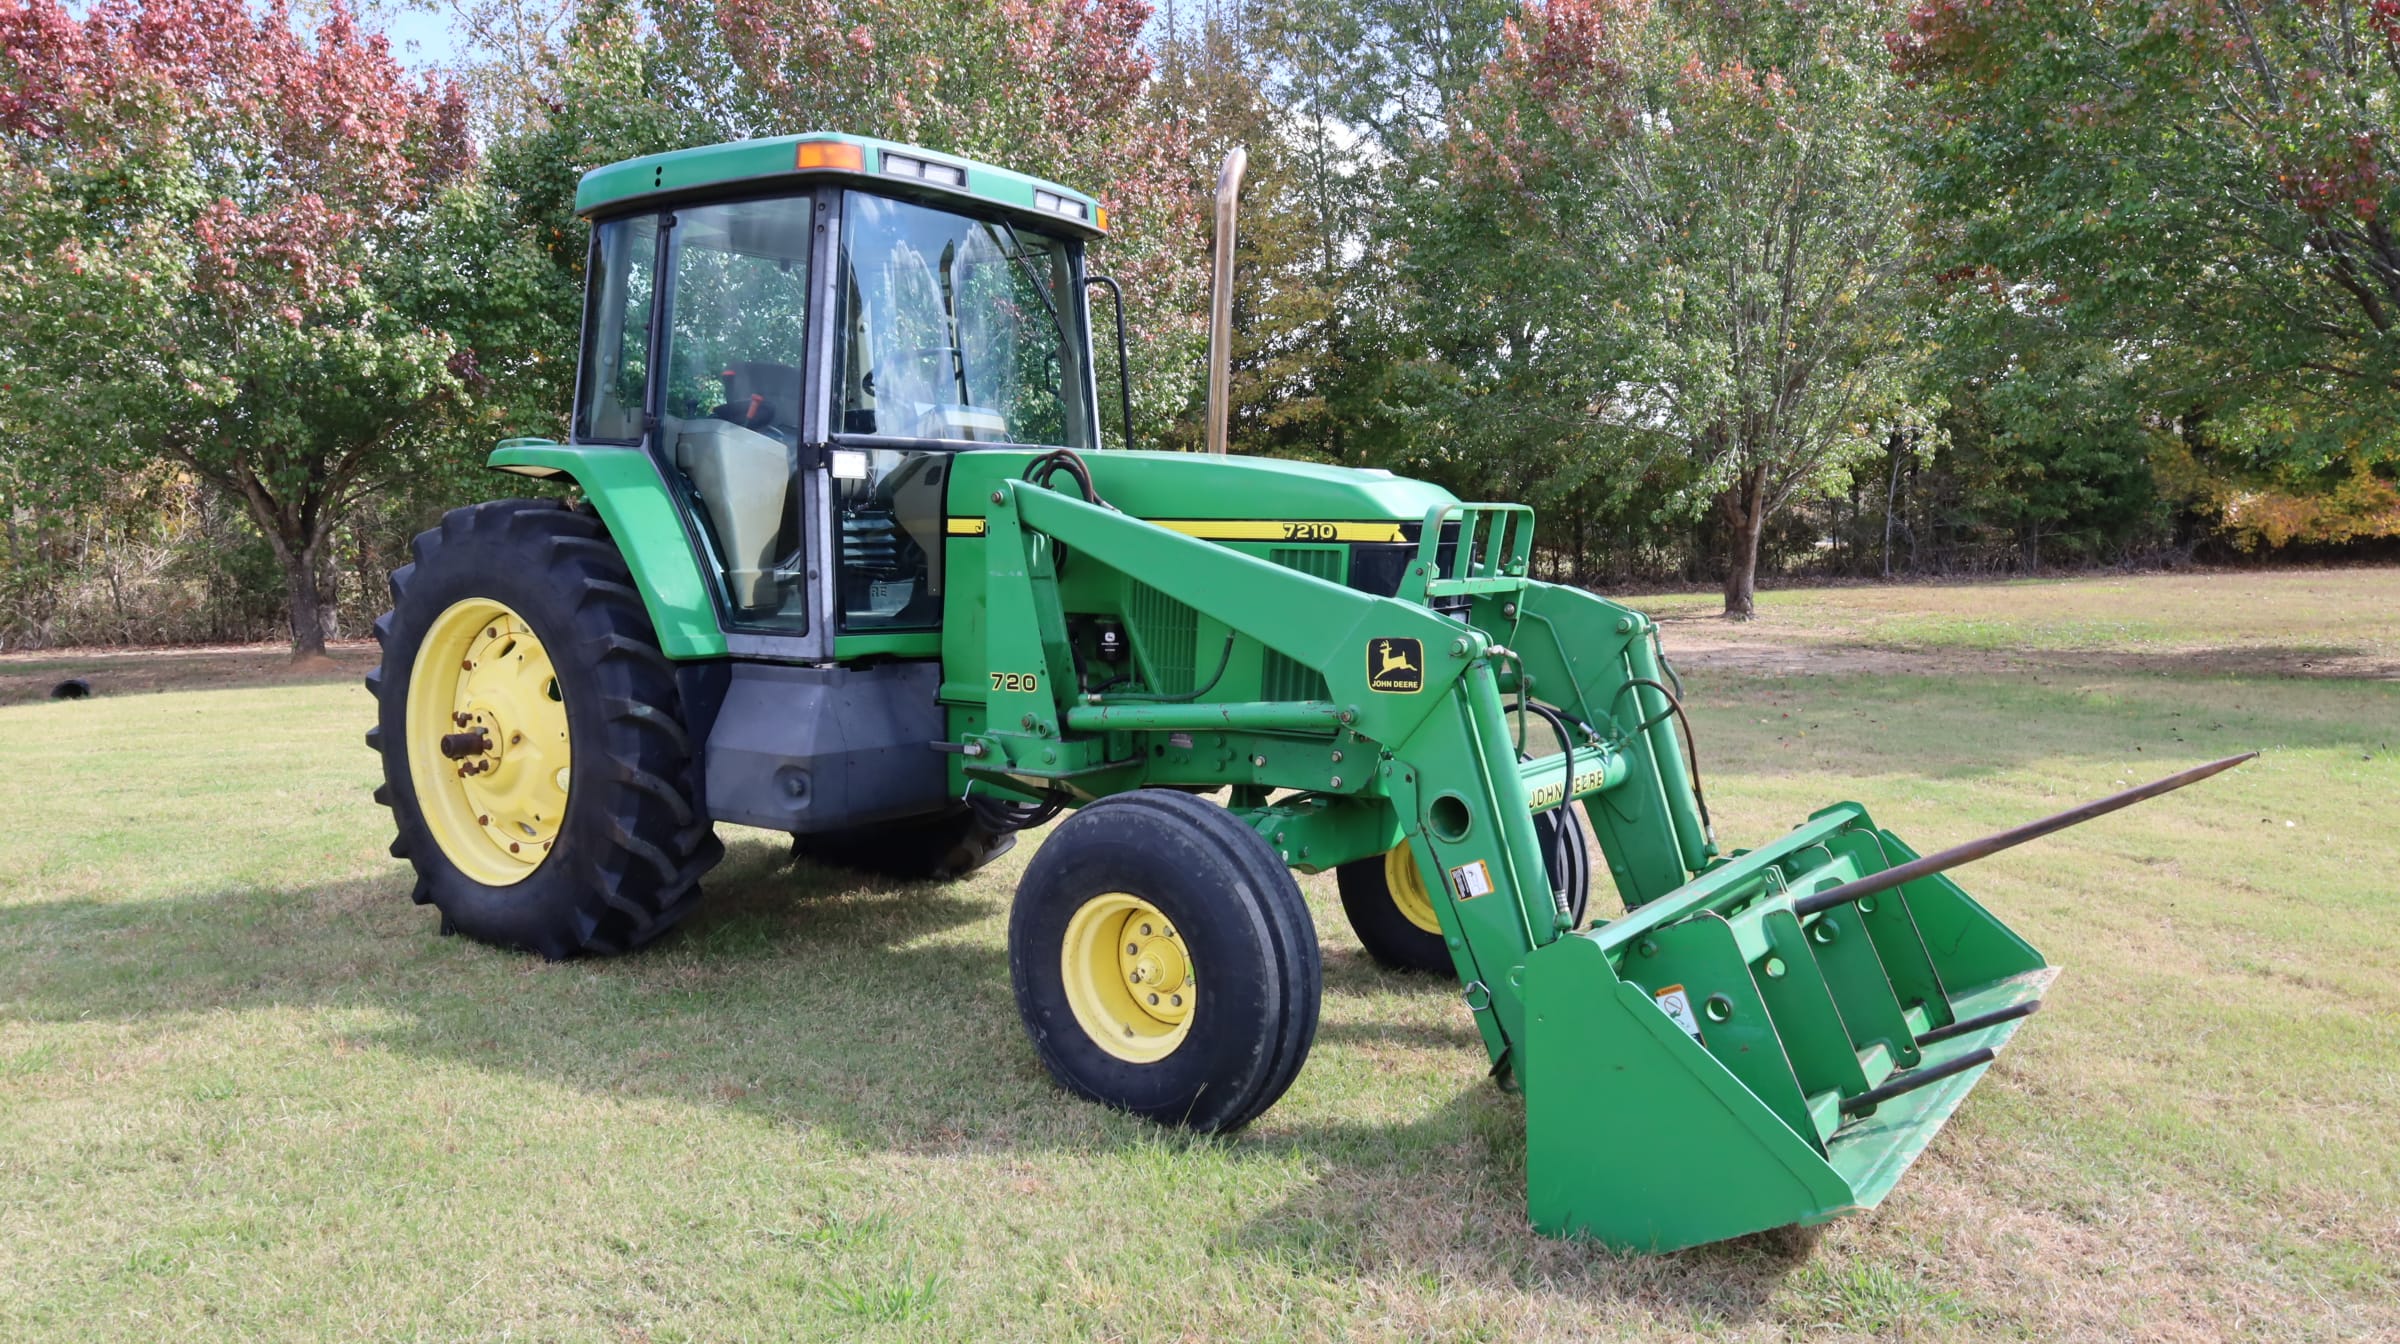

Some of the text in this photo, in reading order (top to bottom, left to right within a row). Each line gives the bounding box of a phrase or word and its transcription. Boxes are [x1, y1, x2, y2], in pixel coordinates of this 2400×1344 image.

[1283, 523, 1337, 539] 7210
[990, 672, 1037, 693] 720
[1371, 680, 1418, 689] JOHN DEERE
[1529, 771, 1603, 808] JOHN EERE
